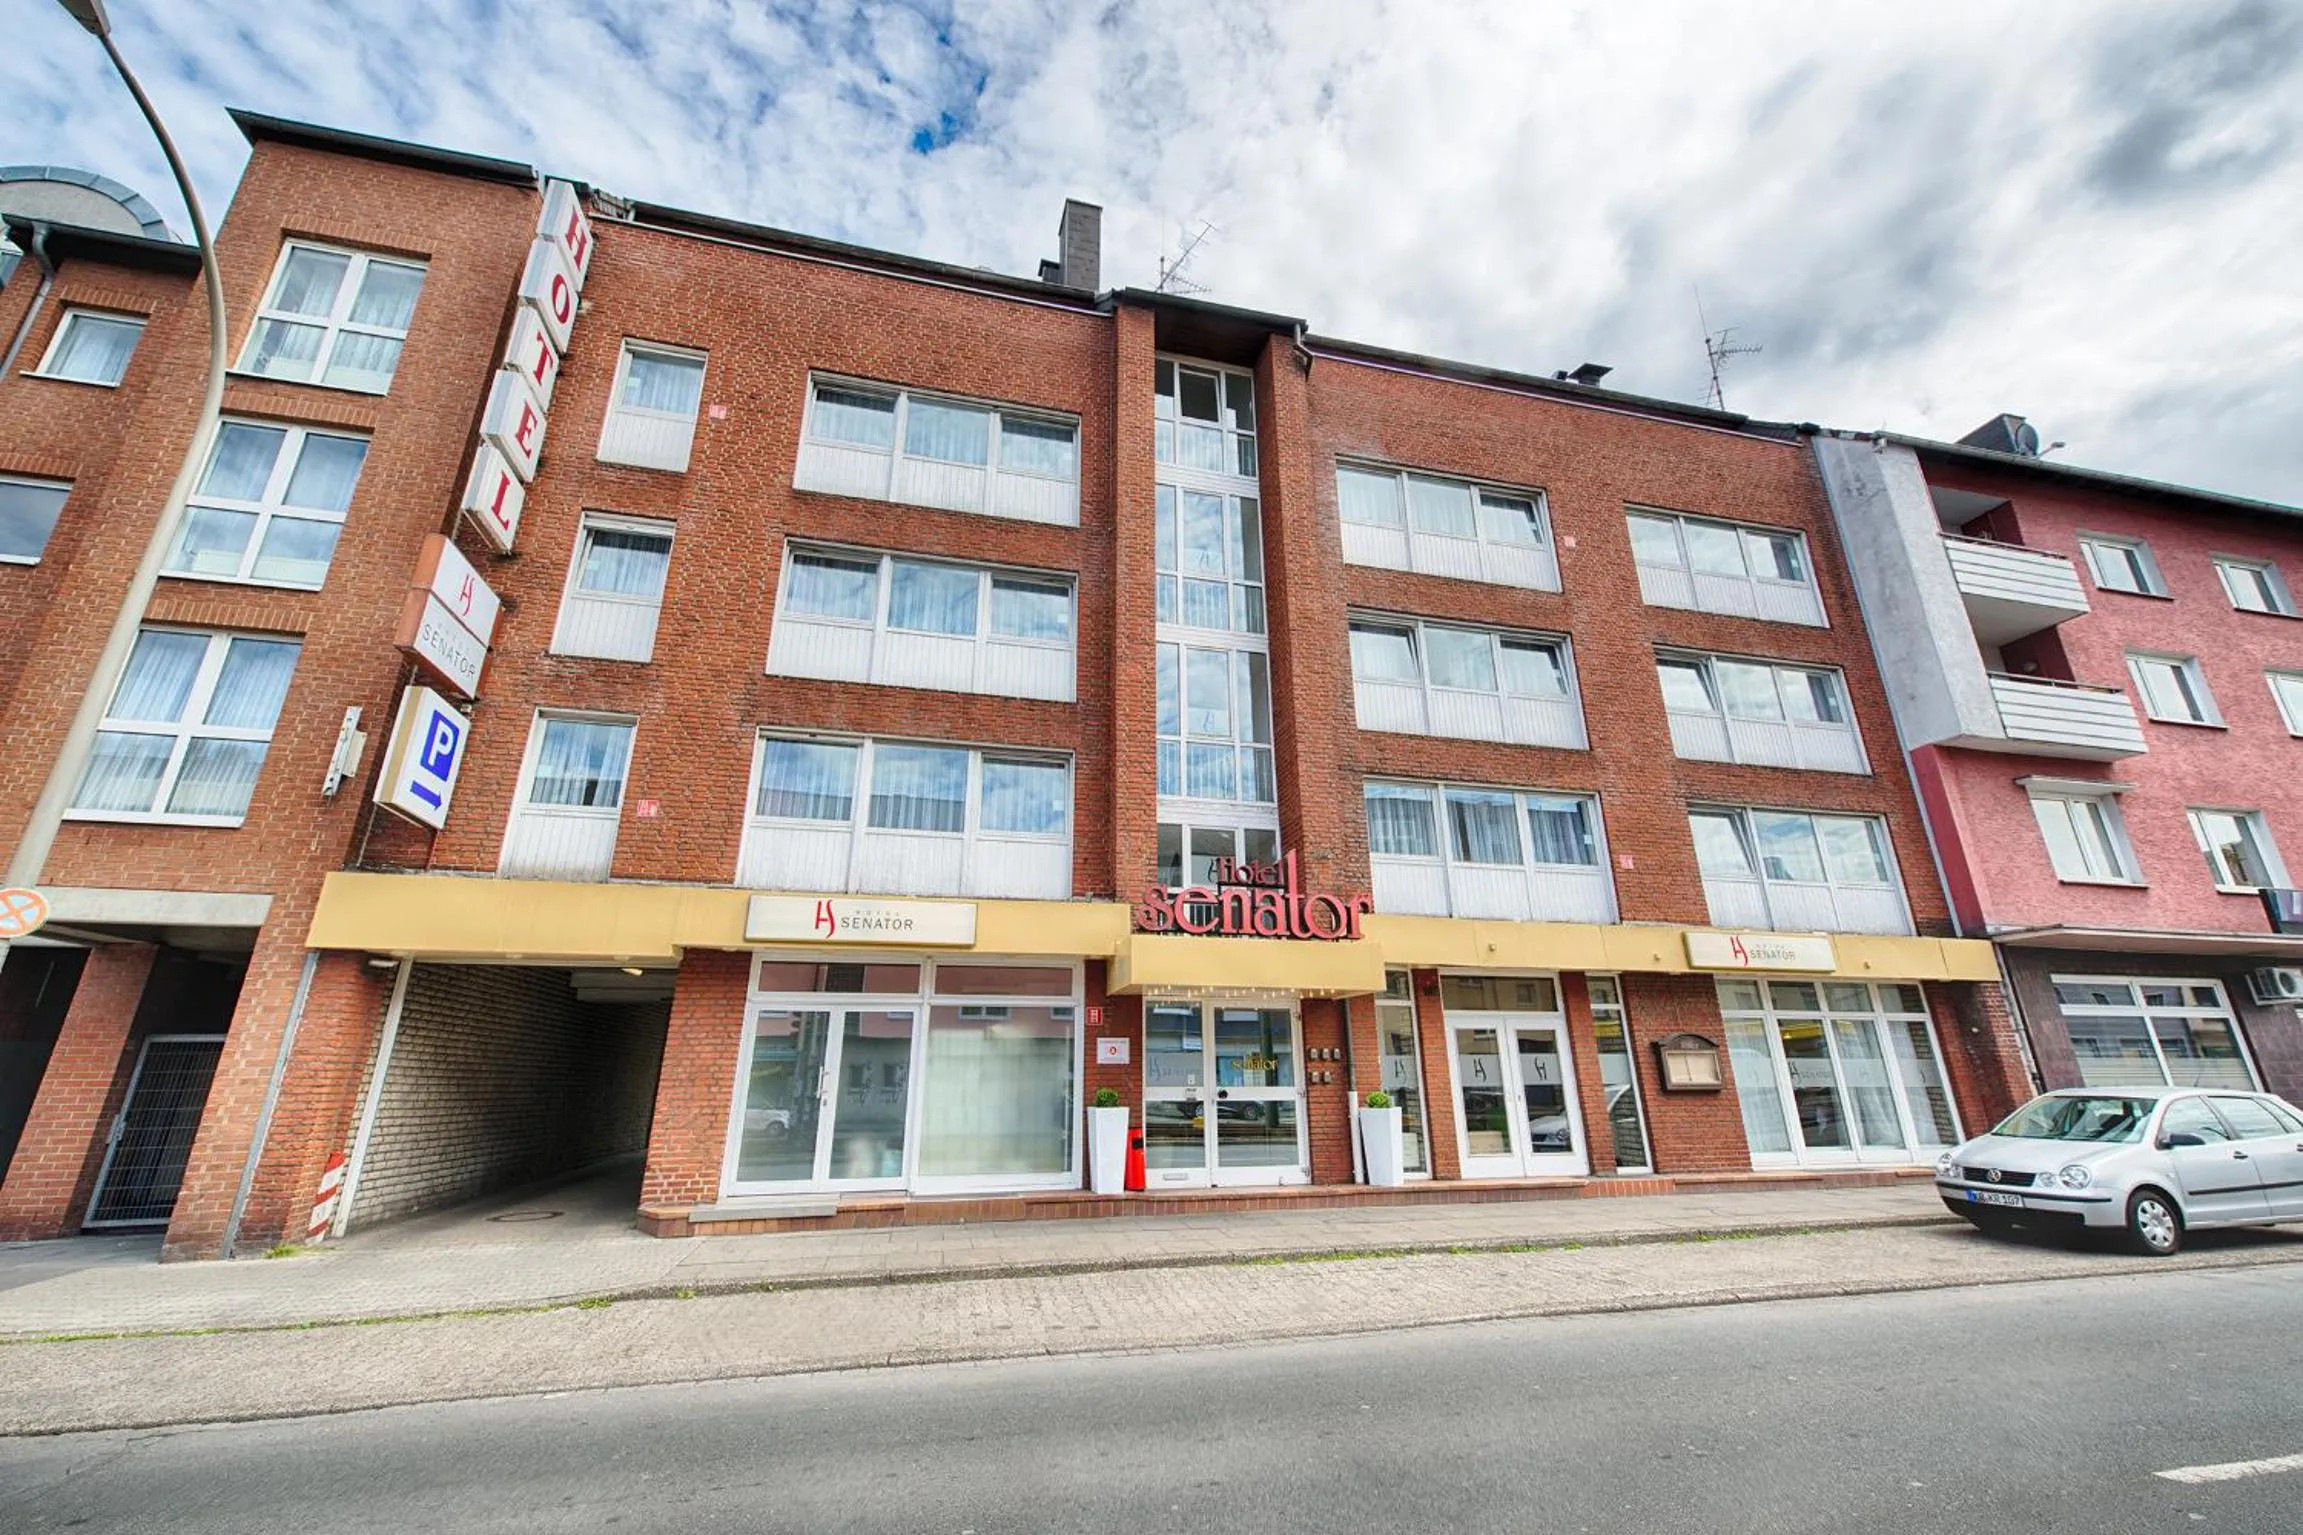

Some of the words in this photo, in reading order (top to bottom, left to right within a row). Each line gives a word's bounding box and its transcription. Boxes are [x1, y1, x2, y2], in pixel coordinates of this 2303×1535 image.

[491, 205, 588, 531] HOTEL
[422, 623, 476, 679] SENATOR
[840, 916, 914, 930] SENATOR
[1749, 949, 1796, 961] SENATOR
